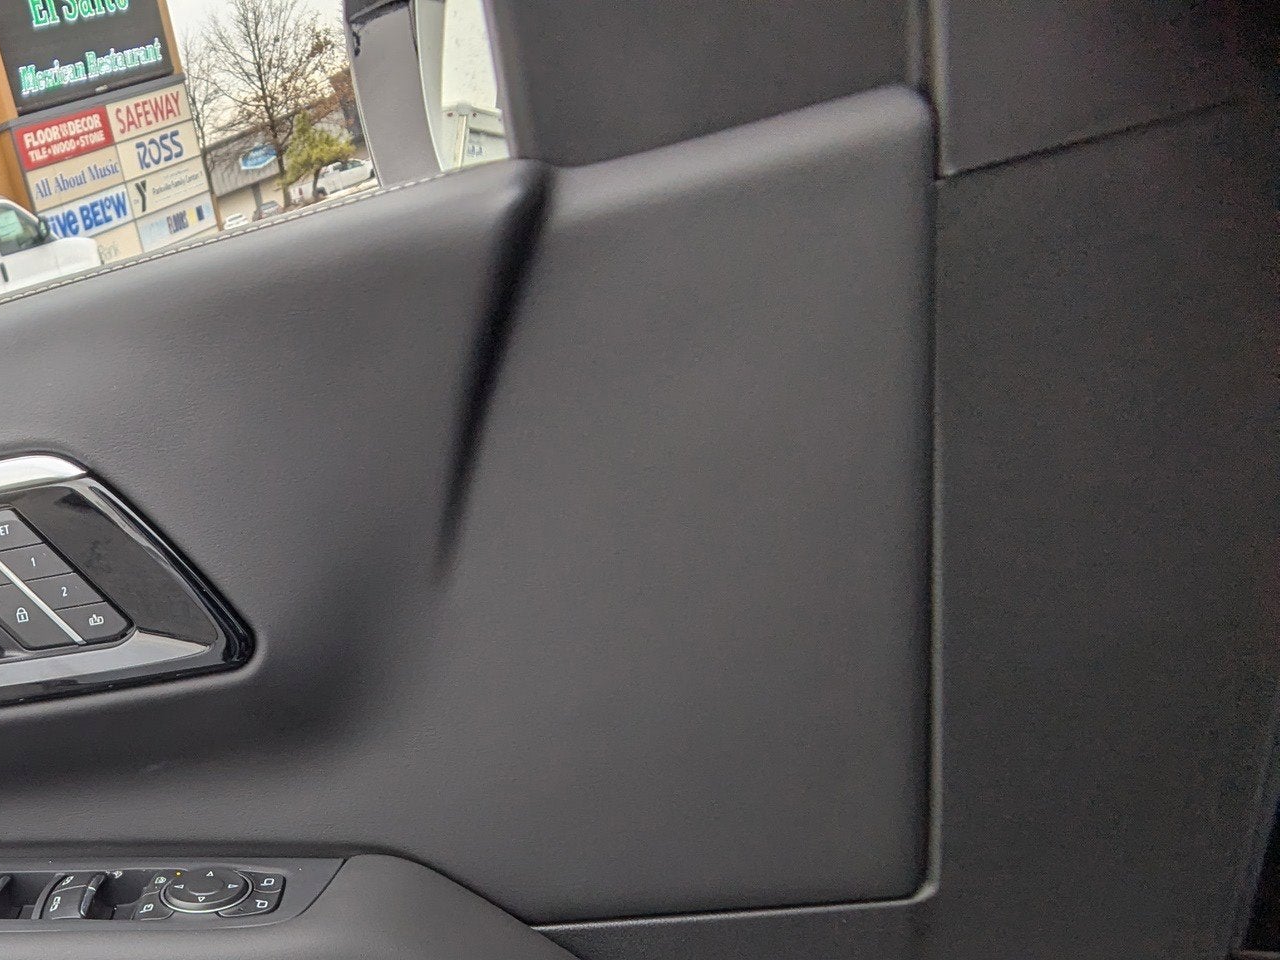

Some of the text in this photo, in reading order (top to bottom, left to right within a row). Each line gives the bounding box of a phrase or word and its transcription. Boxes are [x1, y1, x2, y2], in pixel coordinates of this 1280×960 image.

[29, 0, 60, 27] El
[19, 37, 163, 95] Mexican Restaurant
[115, 91, 181, 134] SAFEWAY
[23, 125, 61, 149] FLOOR
[66, 113, 102, 136] DECOR
[135, 130, 184, 170] ROSS
[35, 158, 119, 199] All About Music
[49, 209, 80, 236] ive
[30, 557, 36, 567] 1
[61, 587, 68, 597] 2
